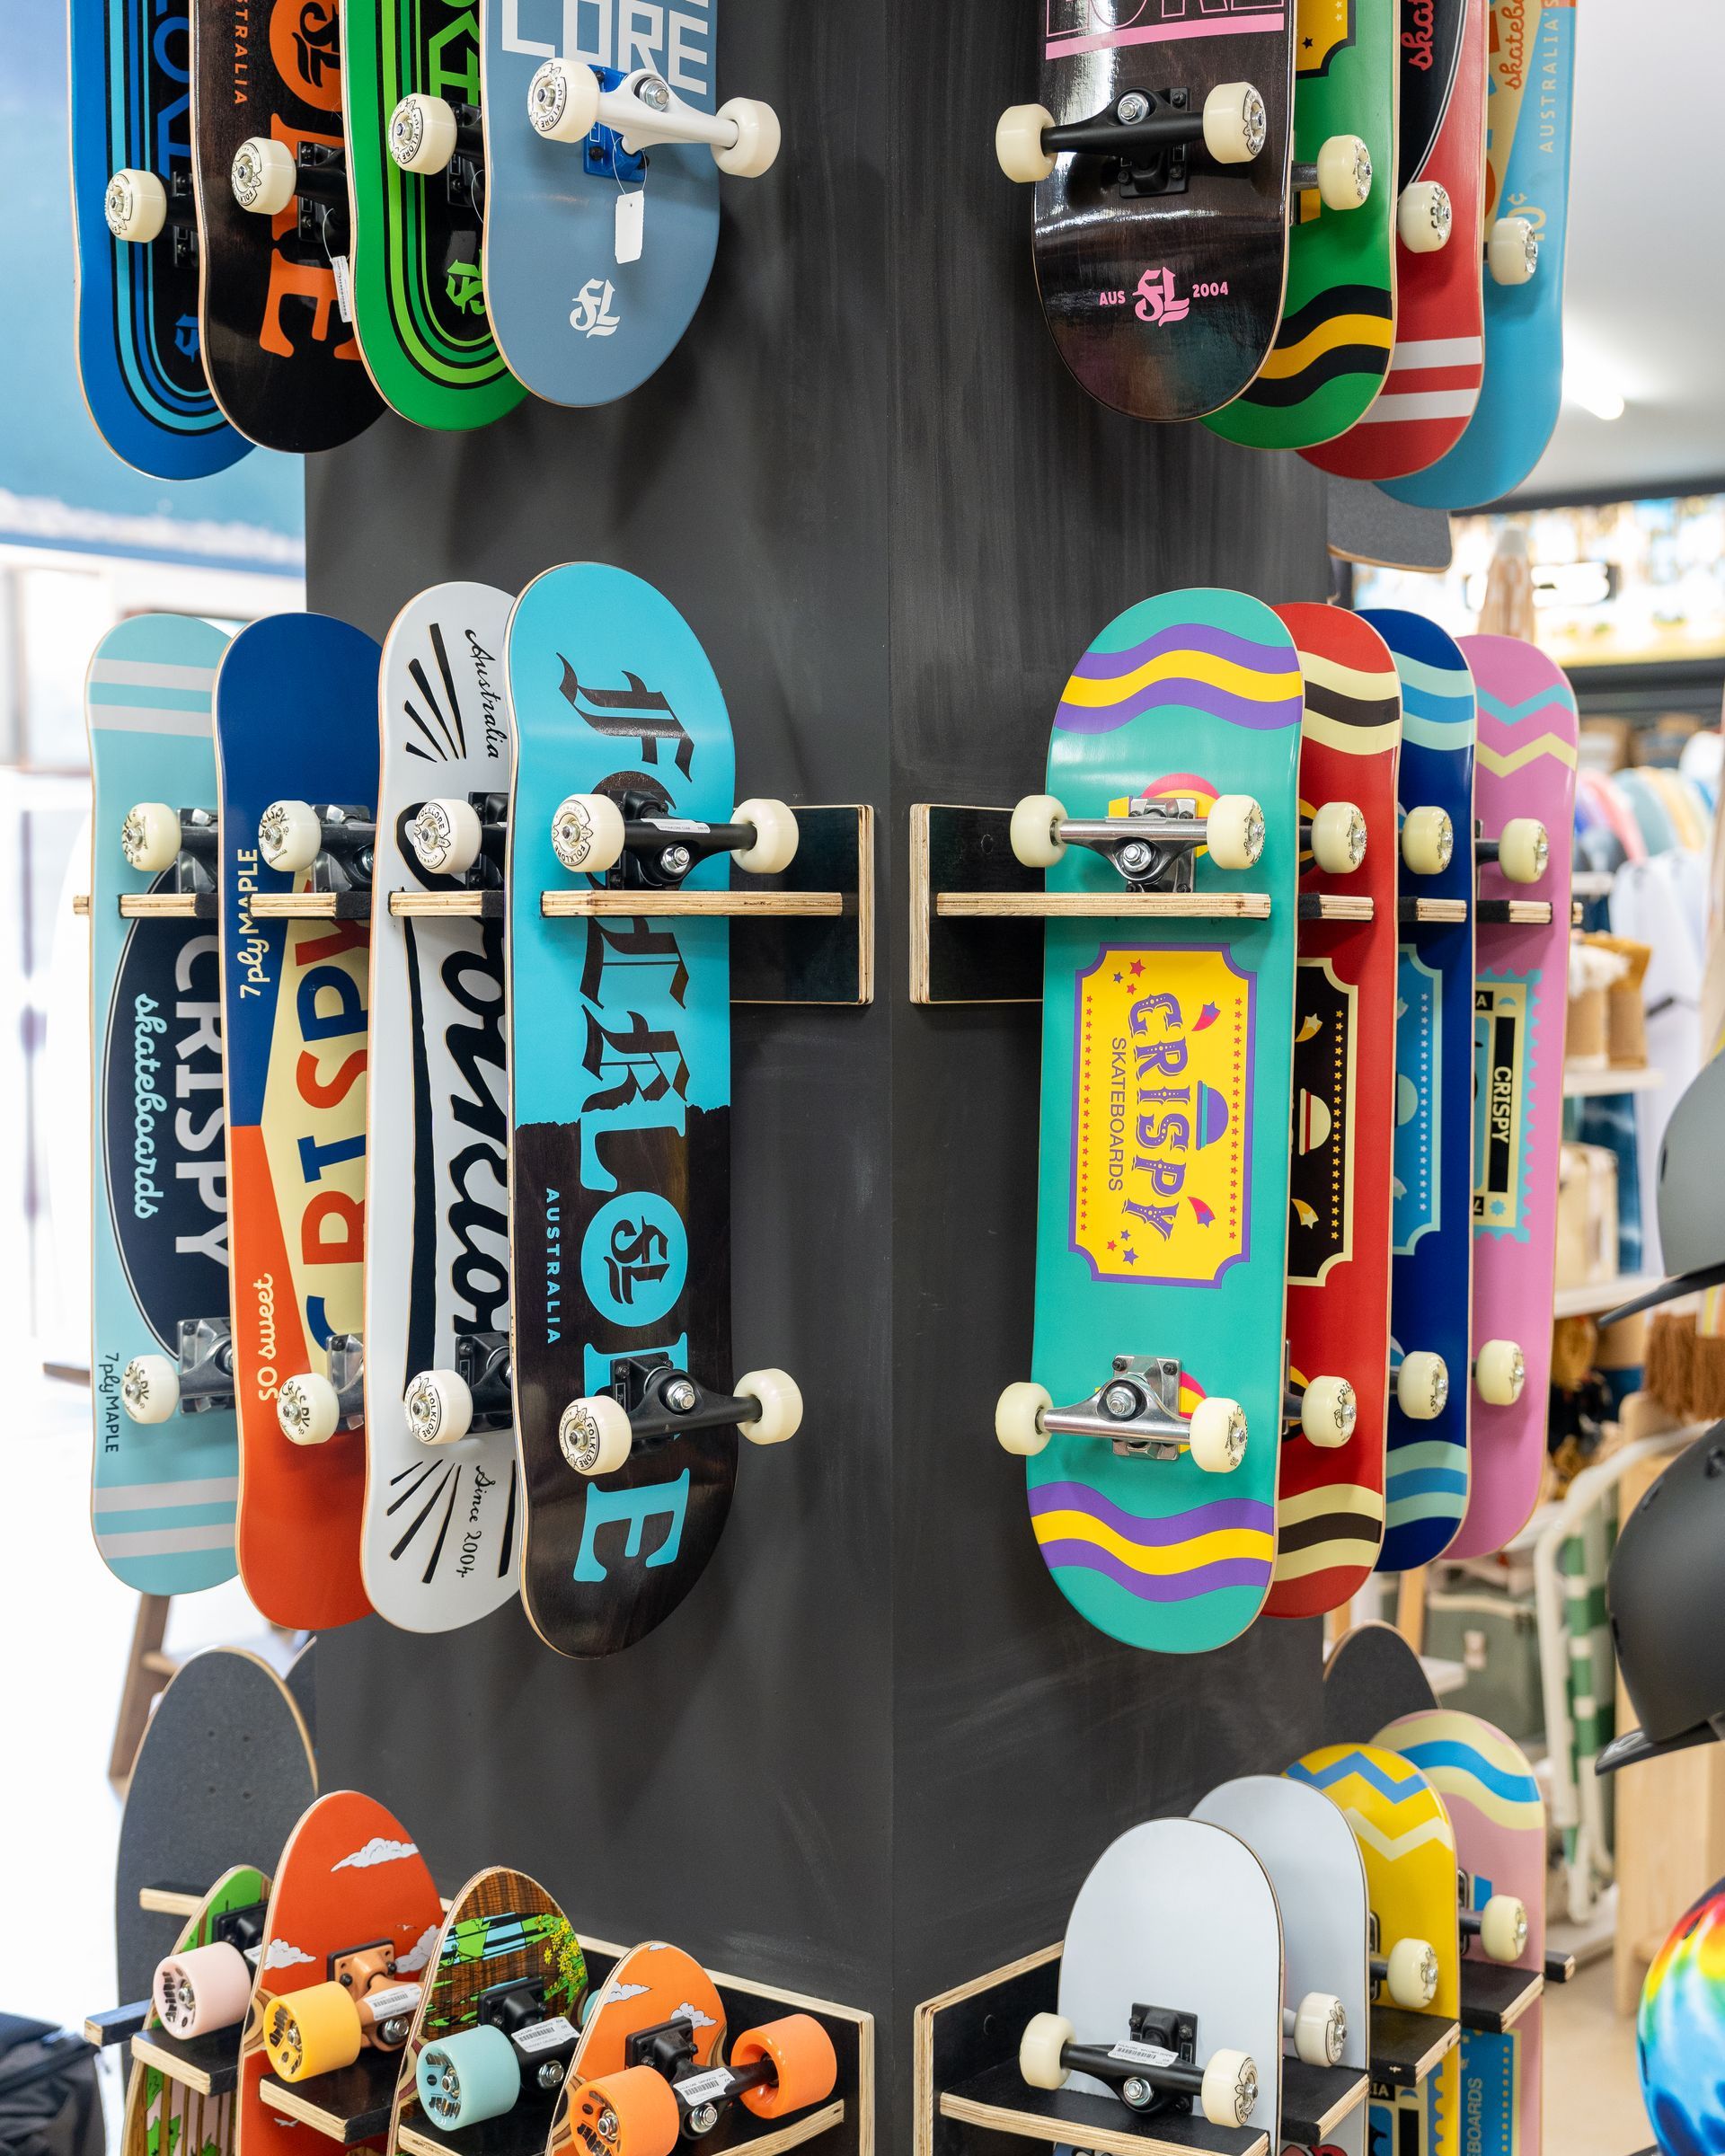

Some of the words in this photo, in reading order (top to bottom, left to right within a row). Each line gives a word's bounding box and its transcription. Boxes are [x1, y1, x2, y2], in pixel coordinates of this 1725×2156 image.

[1099, 291, 1126, 305] AUS
[1192, 281, 1229, 298] 2004
[464, 629, 509, 759] Australia
[417, 803, 447, 830] FOLKLORE
[553, 844, 586, 863] FOLKLORE
[134, 993, 167, 1220] skateboards
[174, 935, 229, 1268] CRISPY
[1108, 1037, 1128, 1191] SKATEBOARDS
[1121, 992, 1191, 1242] CRISPY
[1491, 1065, 1512, 1144] CRISPY
[545, 1188, 562, 1345] AUSTRALIA
[253, 1272, 276, 1360] sweet
[105, 1396, 119, 1453] MAPLE
[420, 1391, 438, 1438] FOLKLORE
[578, 1421, 598, 1470] FOLKLORE
[468, 1465, 496, 1524] Since
[456, 1530, 482, 1578] 2004
